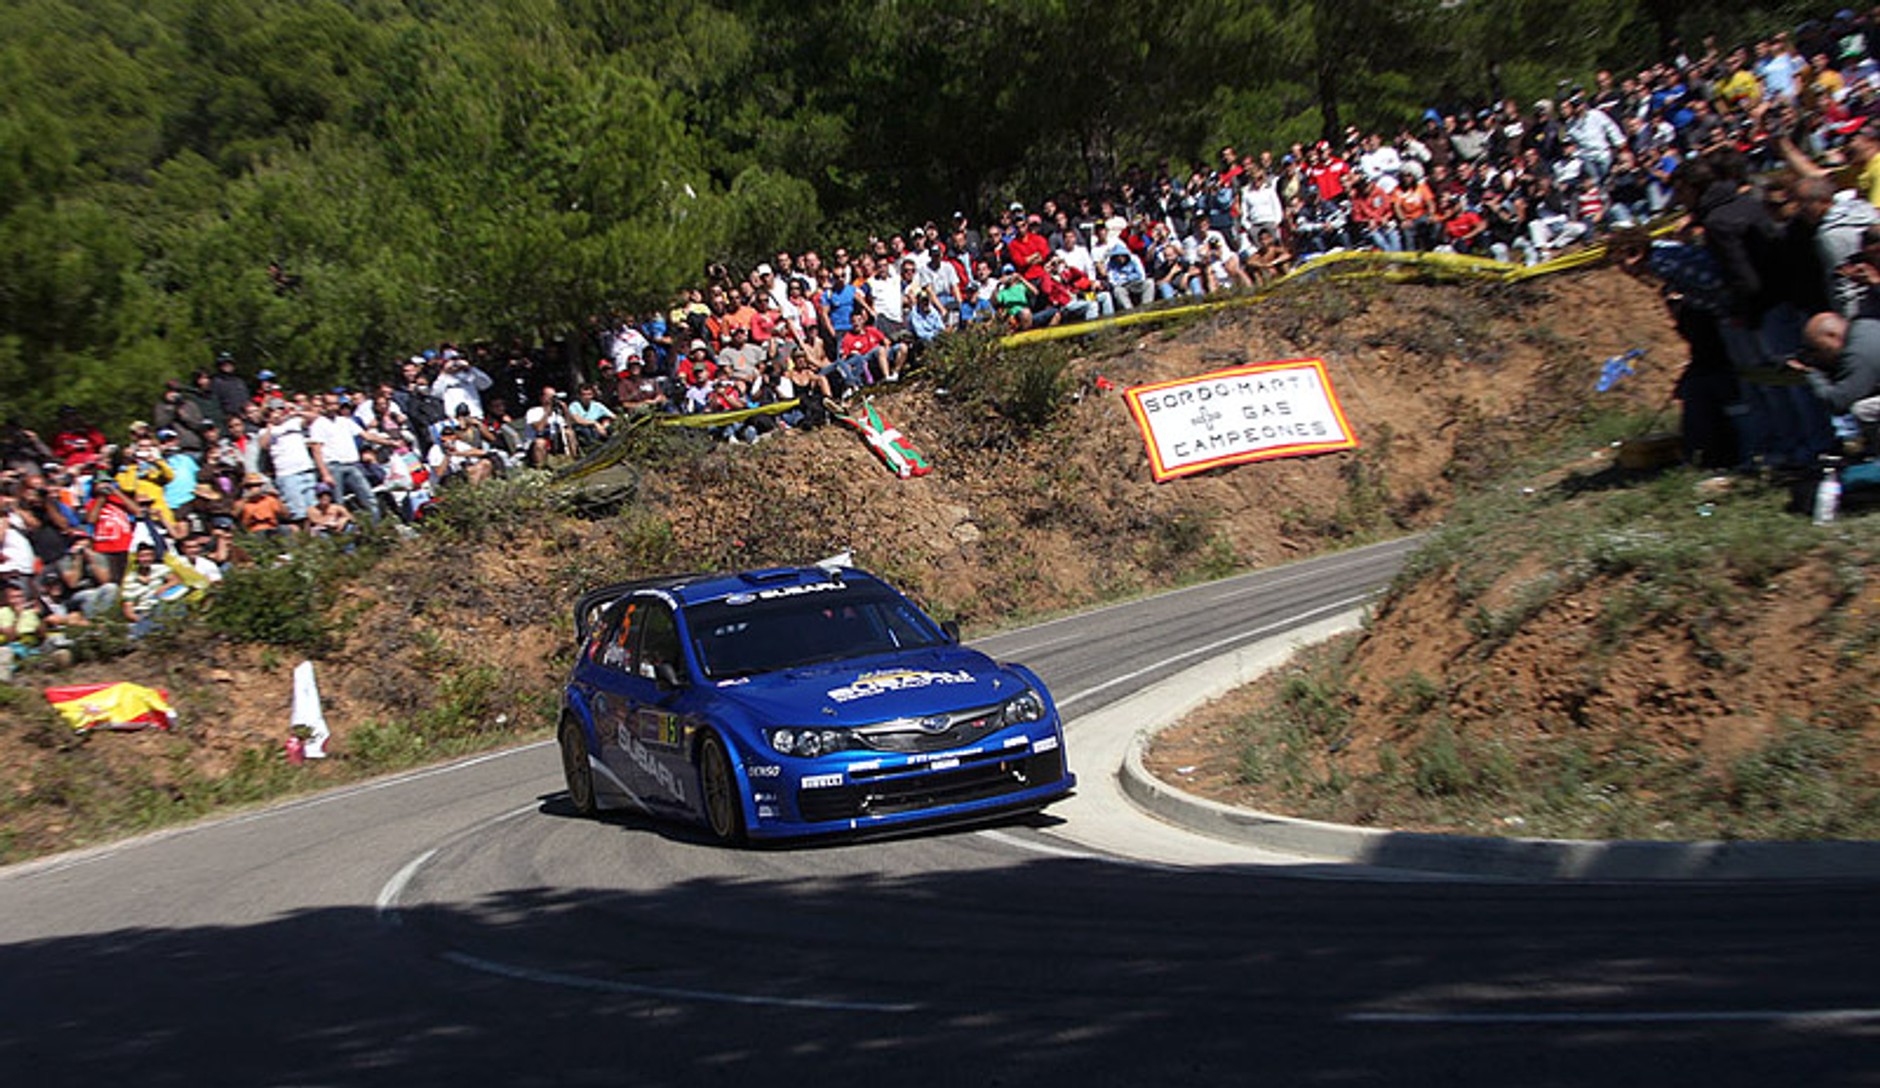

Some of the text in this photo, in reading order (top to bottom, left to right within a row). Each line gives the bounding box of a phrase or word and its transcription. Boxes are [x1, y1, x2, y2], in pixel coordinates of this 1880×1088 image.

[1241, 400, 1292, 420] GAS
[1173, 420, 1327, 458] CAMPEONES
[618, 719, 685, 803] SUBARU
